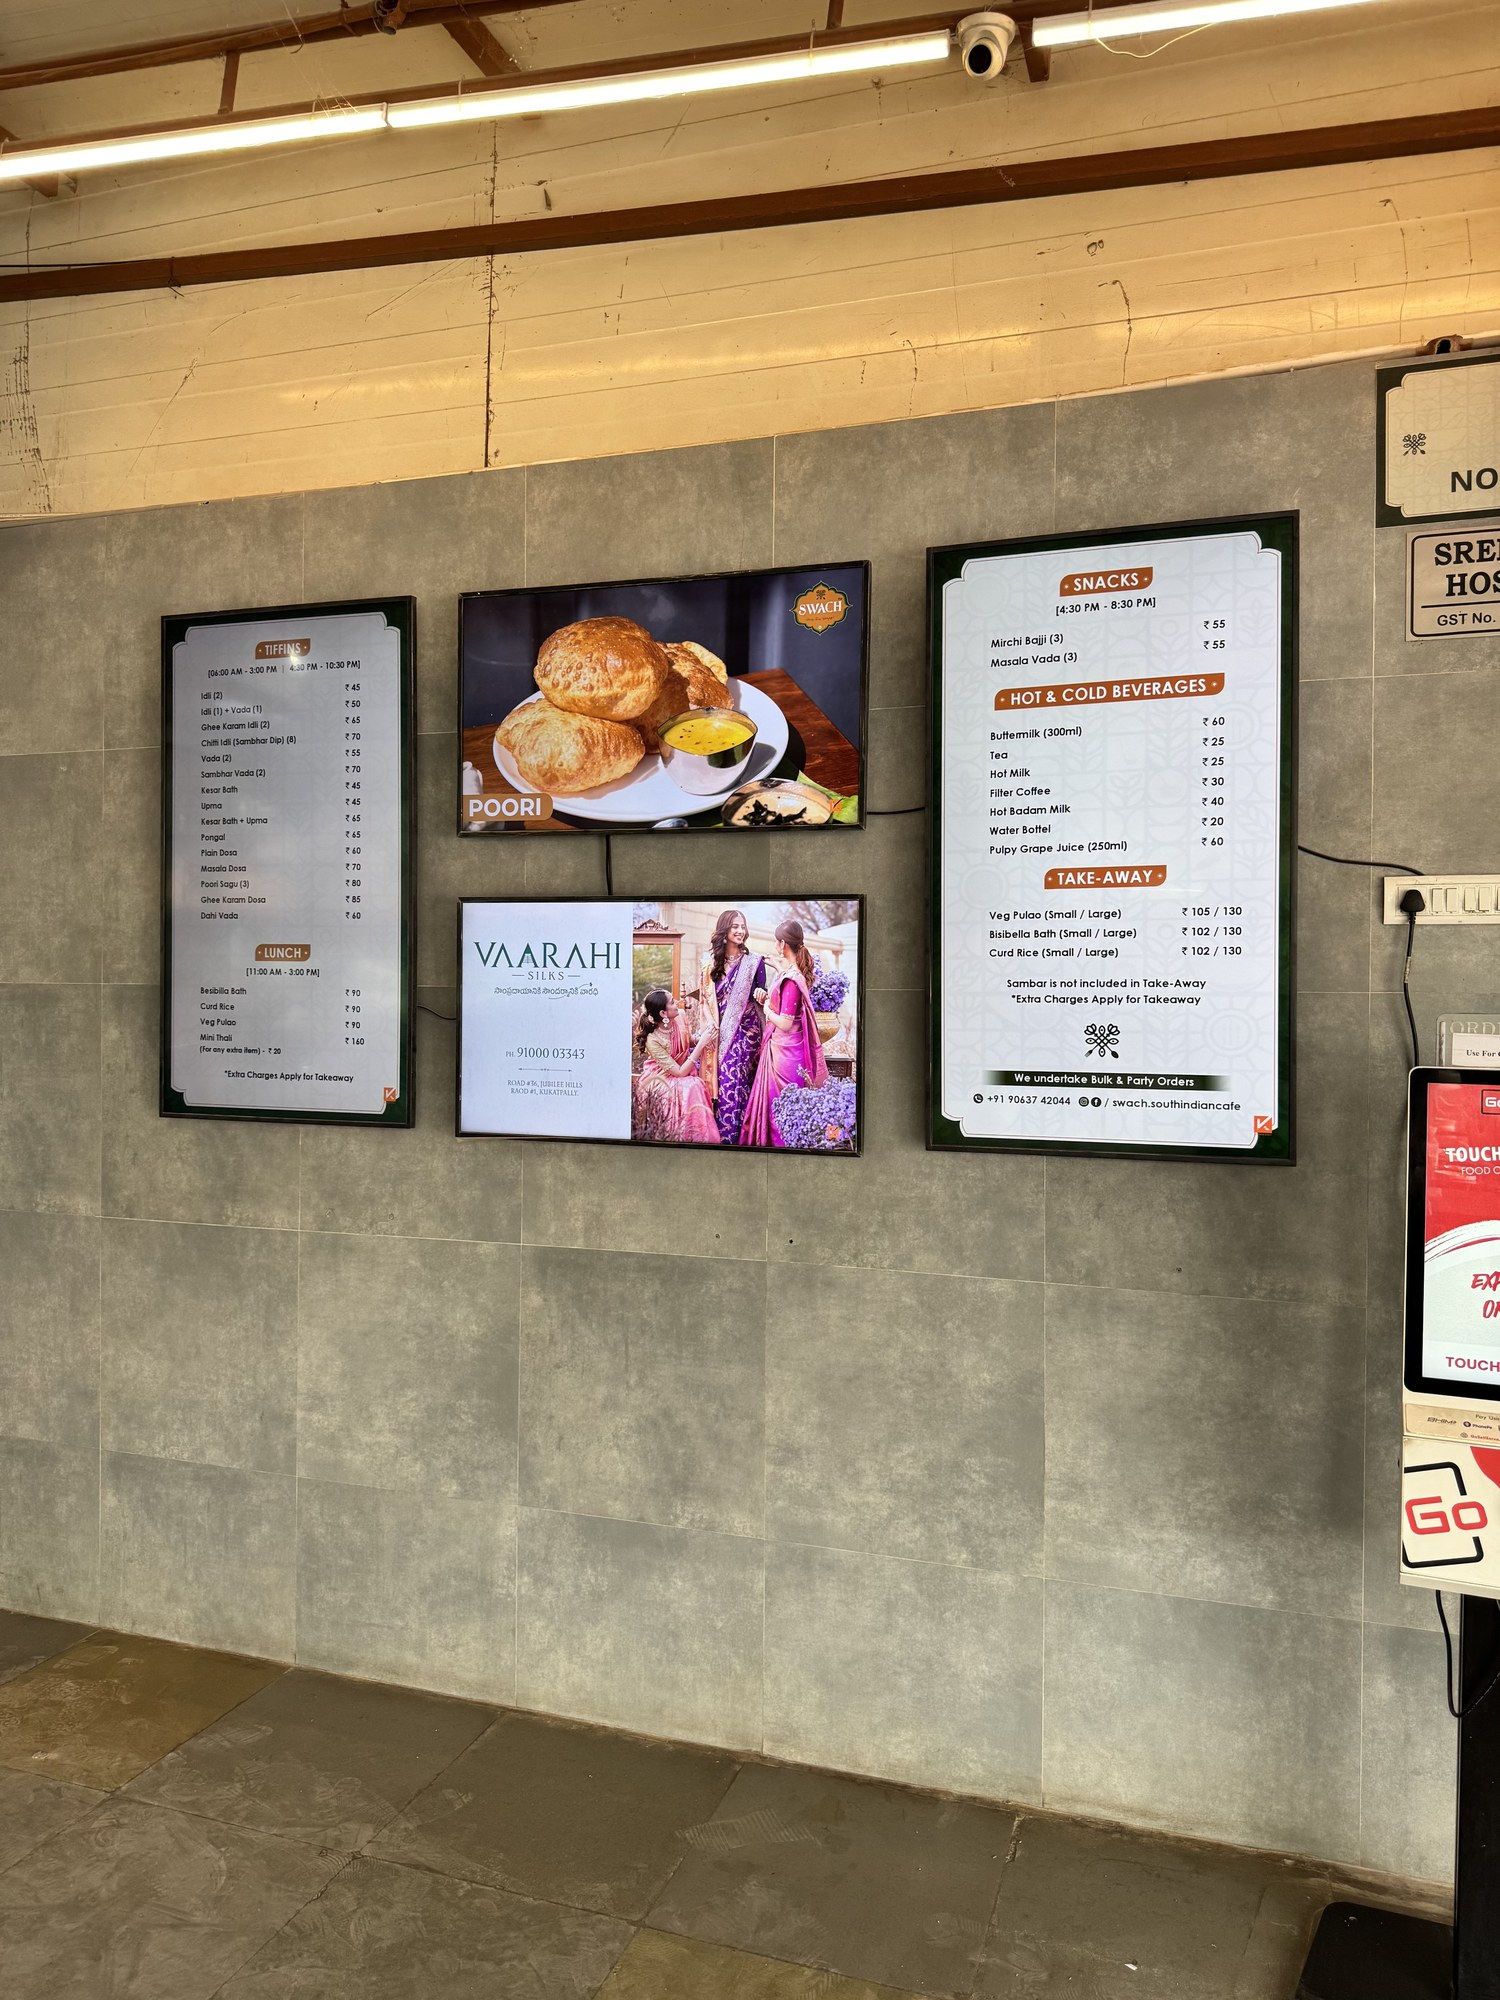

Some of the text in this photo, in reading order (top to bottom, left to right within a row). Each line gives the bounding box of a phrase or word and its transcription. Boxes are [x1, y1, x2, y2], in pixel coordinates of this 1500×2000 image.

[1435, 539, 1500, 566] SRE
[1073, 572, 1138, 591] SNACKS
[799, 601, 842, 615] SWACH
[1056, 604, 1081, 616] [4:30
[1084, 602, 1100, 612] PM
[1111, 599, 1133, 609] 8:30
[1136, 597, 1156, 608] PM]
[1437, 613, 1496, 626] GST No.
[991, 634, 1063, 648] Mirchi Bajji (3)
[265, 642, 301, 655] TIFFINS
[990, 652, 1077, 667] Masala Vada (3)
[213, 691, 222, 700] (2)
[1011, 678, 1207, 705] HOT & COLD BEVERAGES
[260, 720, 270, 729] (2)
[990, 726, 1082, 740] Buttermilk (300ml)
[990, 751, 1008, 760] Tea
[255, 768, 266, 778] (2)
[990, 768, 1030, 778] Hot Milk
[990, 786, 1050, 797] Filter Coffee
[201, 802, 222, 811] Upma
[469, 798, 541, 817] POORI
[990, 804, 1070, 816] Hot Badam Milk
[989, 824, 1050, 835] Water Bottel
[200, 833, 225, 842] Pongal
[990, 840, 1127, 855] Pulpy Grape Juice (250ml)
[1057, 870, 1152, 885] TAKE-AWAY
[220, 880, 238, 889] Sagu
[240, 880, 249, 889] (3)
[989, 912, 1010, 921] Veg
[1013, 910, 1041, 919] Pulao
[1044, 909, 1076, 920] (Small
[1088, 909, 1121, 919] Large)
[990, 929, 1030, 938] Bisibella
[1034, 929, 1056, 938] Bath
[1059, 928, 1091, 939] (Small
[1103, 928, 1136, 939] Large)
[264, 947, 301, 958] LUNCH
[474, 942, 621, 968] VAARAHI
[989, 948, 1013, 957] Curd
[1017, 948, 1038, 957] Rice
[1042, 948, 1074, 958] (Small
[1085, 948, 1118, 958] Large)
[246, 968, 268, 976] [11:00
[306, 968, 319, 978] PM]
[528, 971, 564, 980] SILKS
[1007, 979, 1206, 989] Sambar is not included in Take-Away
[1044, 994, 1088, 1005] Charges
[1092, 995, 1123, 1005] Apply
[1126, 994, 1141, 1003] for
[1143, 995, 1201, 1006] Takeaway
[200, 1018, 215, 1027] Veg
[1450, 1022, 1500, 1034] ORD
[517, 1047, 549, 1058] 91000
[552, 1048, 584, 1059] 03343
[247, 1071, 278, 1080] Charges
[279, 1072, 302, 1081] Apply
[315, 1073, 353, 1083] Takeaway
[1014, 1073, 1194, 1087] We undertake Bulk & Party Orders
[987, 1095, 1070, 1105] +91 90637 42044
[1112, 1099, 1240, 1110] swach.southindiancafe
[1462, 1167, 1490, 1175] FOOD
[1446, 1356, 1500, 1372] TOUCH
[1405, 1495, 1488, 1535] Go
